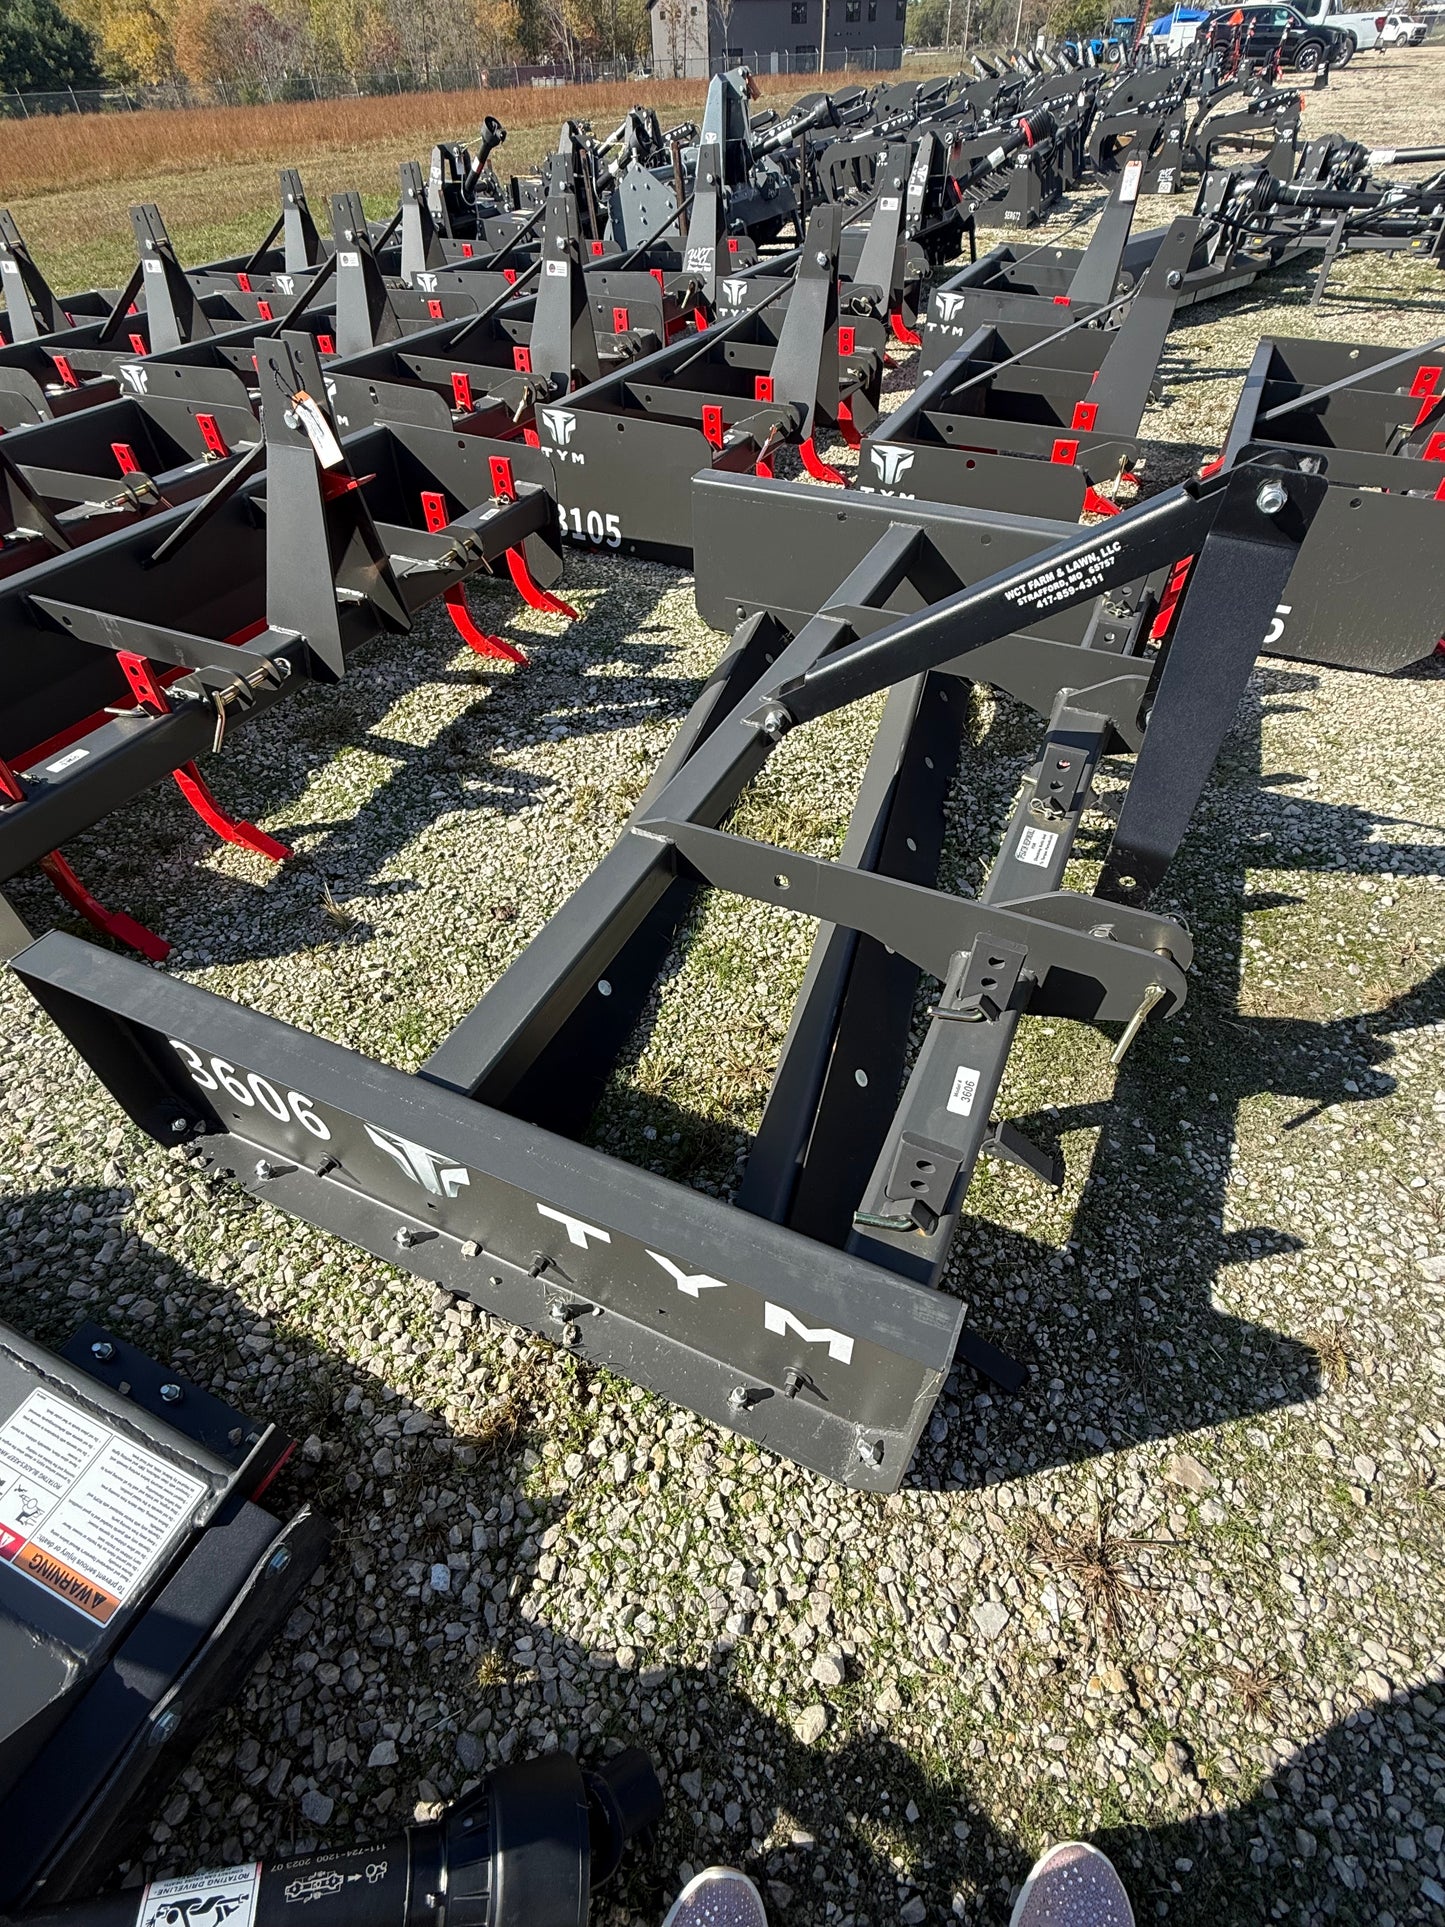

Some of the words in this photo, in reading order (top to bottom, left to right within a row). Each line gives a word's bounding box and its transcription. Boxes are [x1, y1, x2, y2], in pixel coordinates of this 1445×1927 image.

[927, 322, 963, 337] TYM
[541, 446, 585, 465] TYM
[1004, 585, 1027, 601] WCT
[1027, 572, 1056, 591] FARM
[1056, 568, 1065, 578] &
[1065, 552, 1100, 574] LAWN,
[1100, 541, 1121, 558] LLC
[1016, 579, 1068, 606] STRAFFORD,
[1068, 572, 1083, 583] MO
[1088, 556, 1115, 574] 65757
[1036, 573, 1104, 608] 417-859-4311
[169, 1039, 331, 1140] 3606
[960, 1080, 975, 1103] 3606
[52, 1544, 62, 1553] or
[74, 1558, 97, 1576] serious
[28, 1552, 97, 1608] WARNING
[94, 1570, 119, 1589] prevent
[115, 1584, 126, 1595] To
[317, 1843, 387, 1863] 111-724-1200
[286, 1858, 311, 1869] 2023
[207, 1873, 250, 1886] ROTATING
